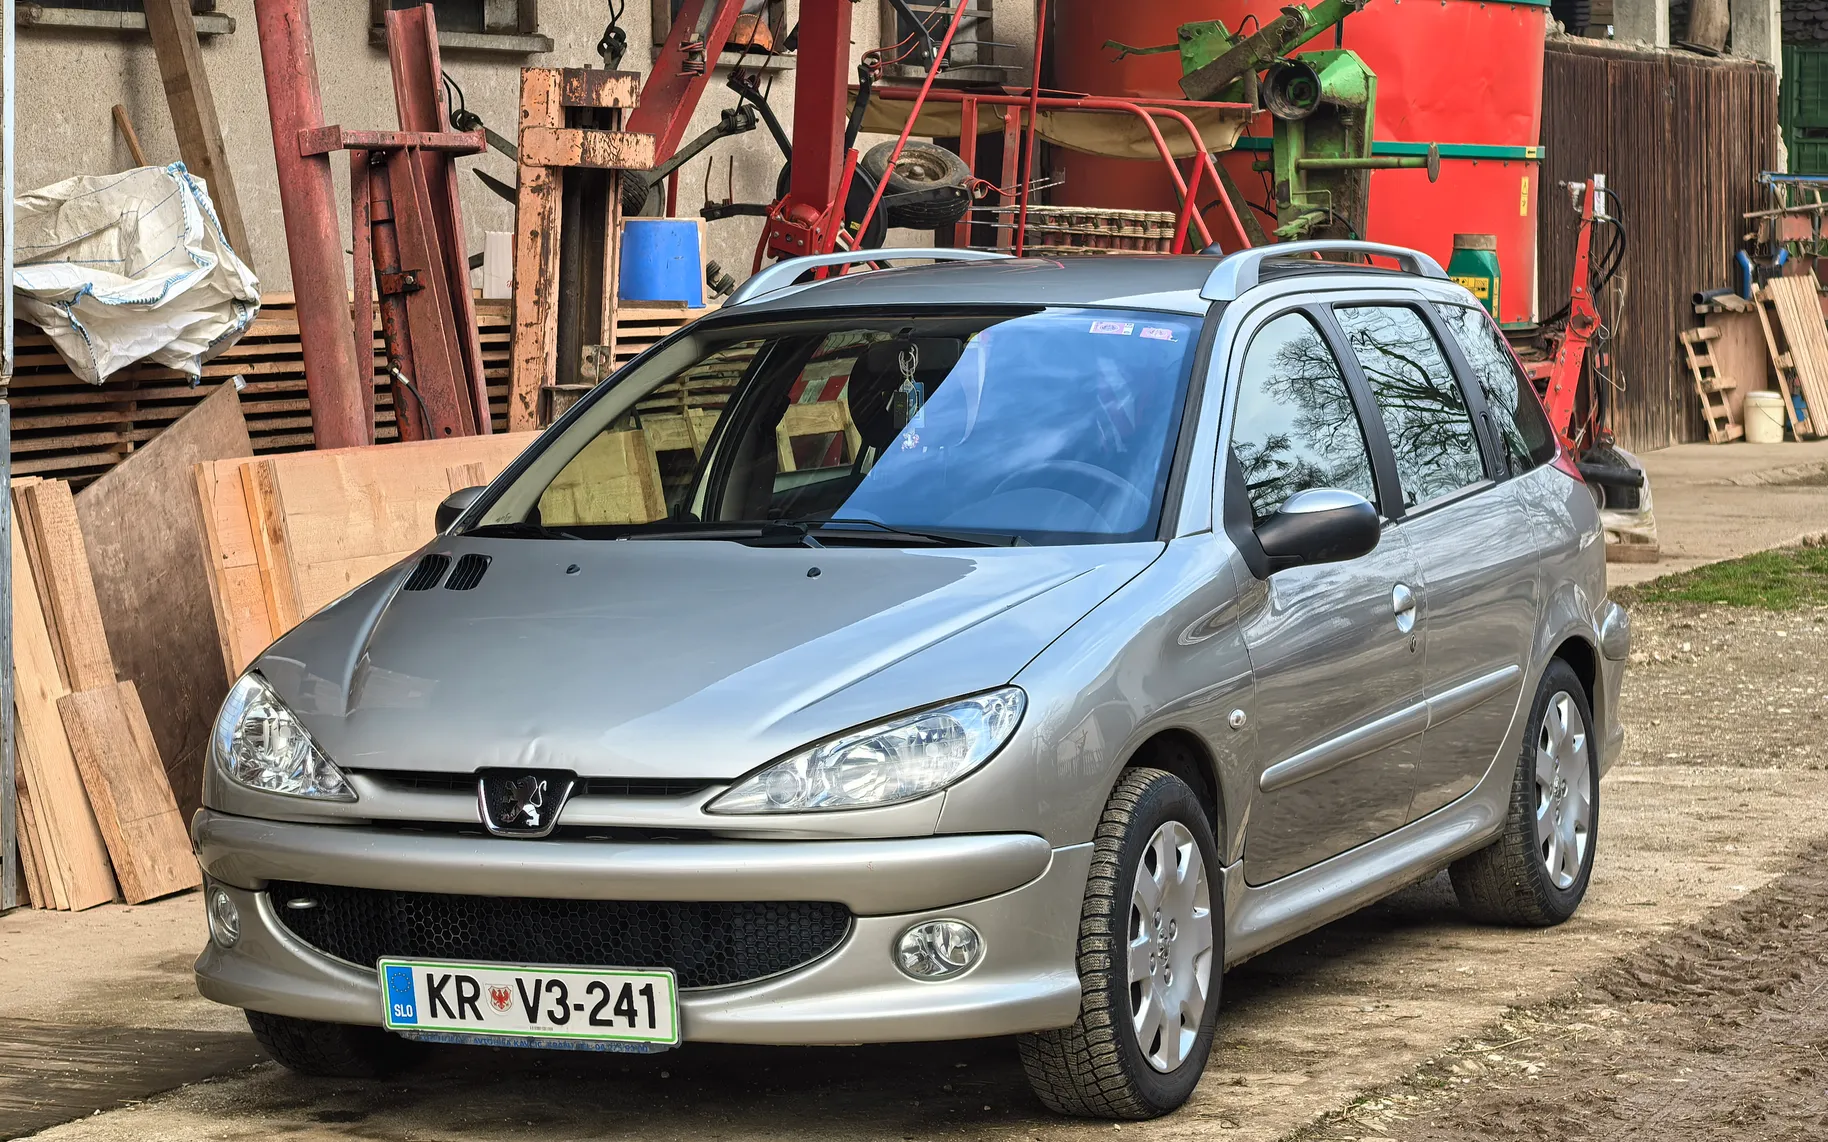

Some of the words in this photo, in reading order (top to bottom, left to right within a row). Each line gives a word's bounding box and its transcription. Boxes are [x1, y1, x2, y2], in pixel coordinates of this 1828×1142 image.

[394, 1003, 413, 1018] SLO
[426, 973, 484, 1021] KR
[515, 977, 656, 1030] V3-241
